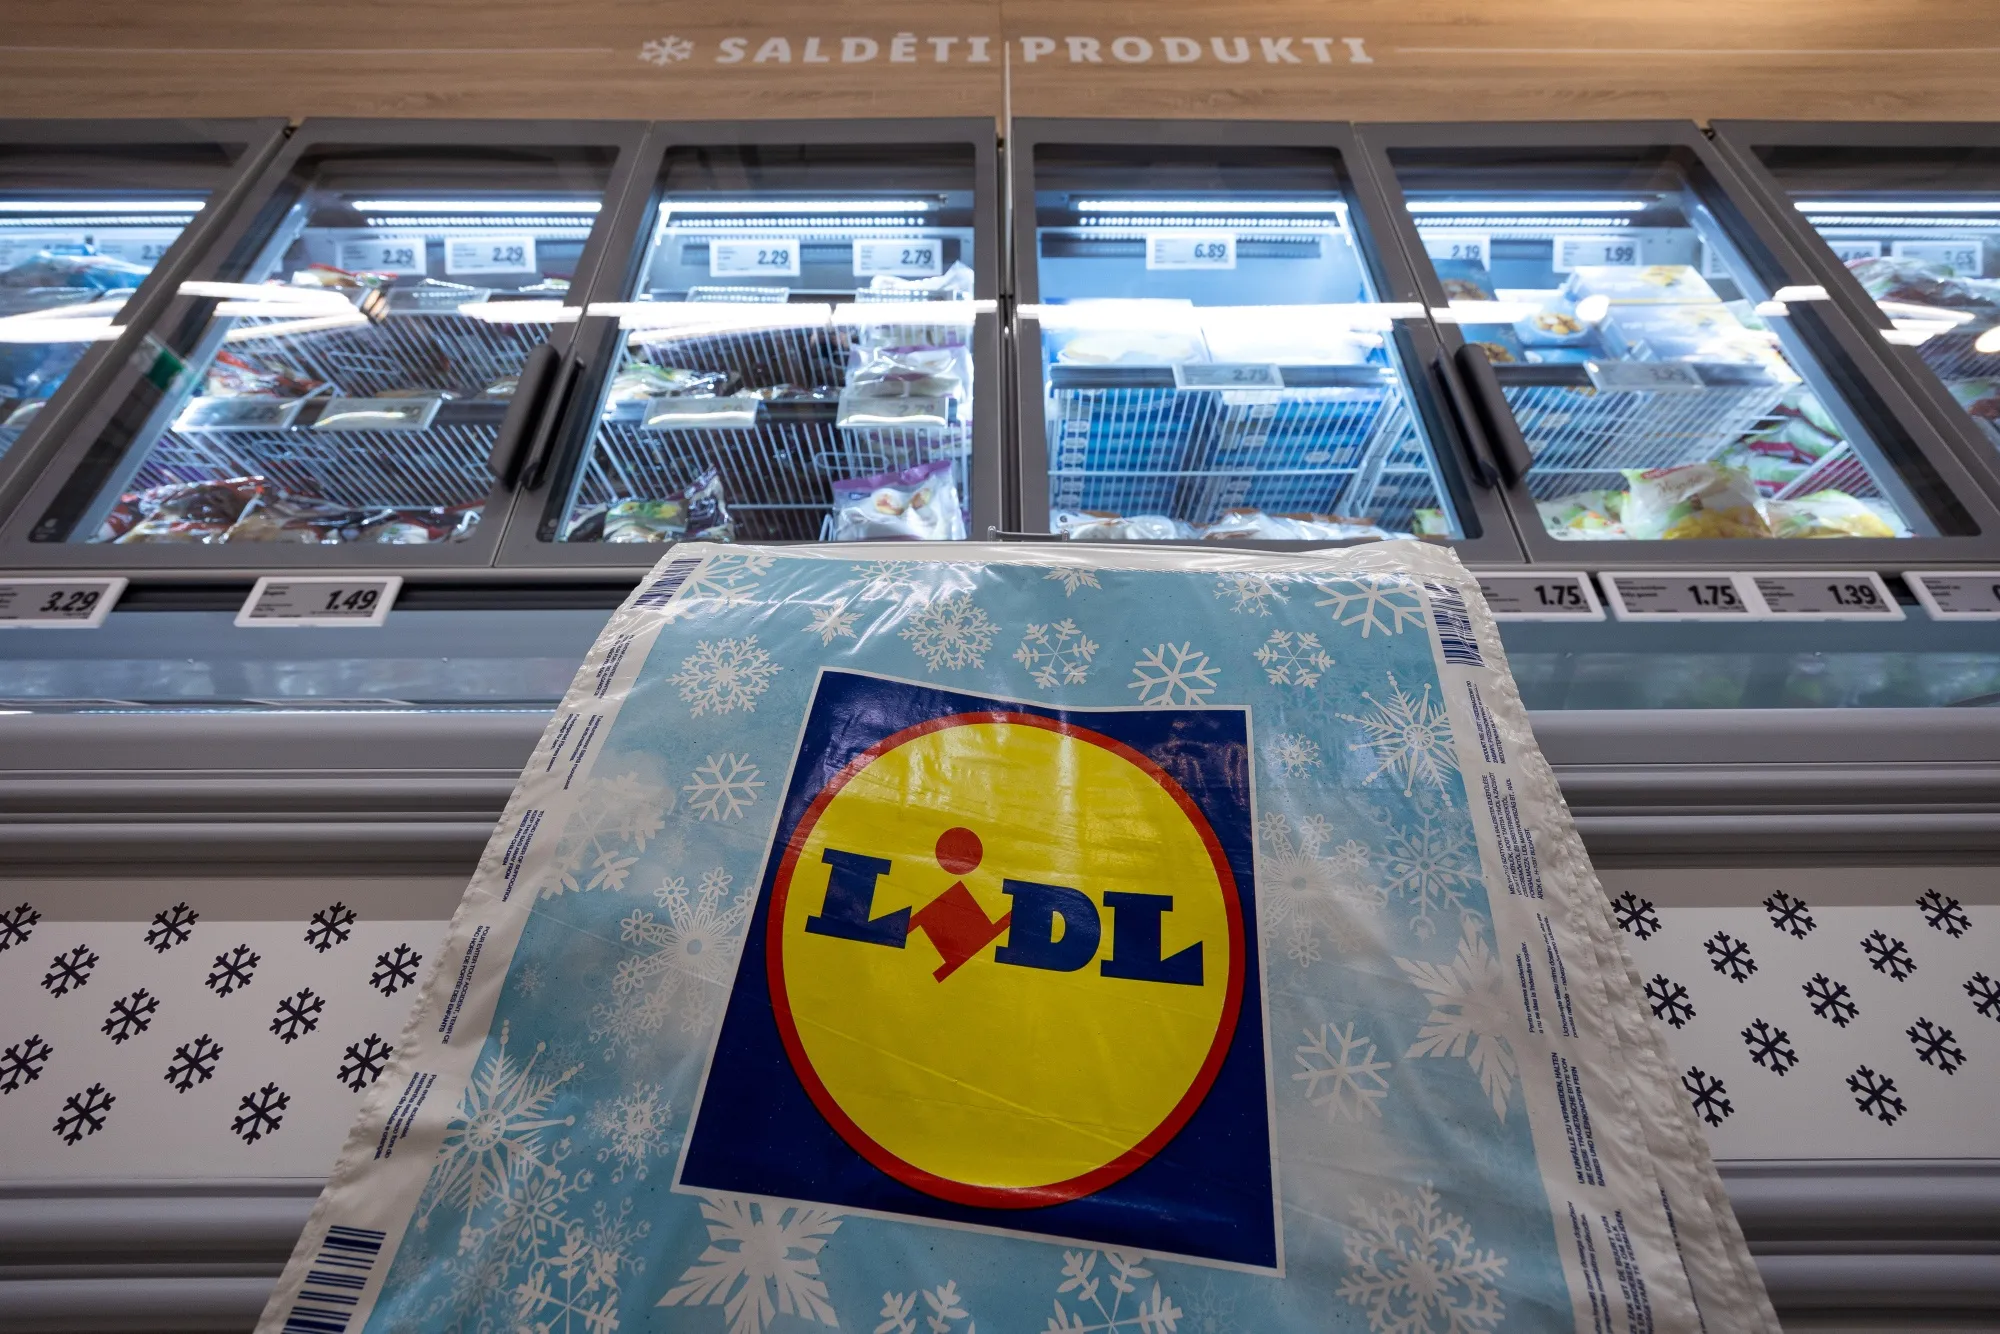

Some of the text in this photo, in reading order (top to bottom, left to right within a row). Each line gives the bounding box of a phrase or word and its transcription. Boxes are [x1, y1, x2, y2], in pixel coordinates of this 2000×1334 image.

[716, 32, 1375, 65] SALDĒTI PRODUKTI
[383, 249, 414, 265] 2.29
[492, 246, 524, 262] 2.29
[757, 250, 789, 265] 2.29
[900, 249, 933, 264] 2.79
[1193, 243, 1226, 259] 6.89
[1604, 247, 1634, 262] 1.99
[40, 591, 100, 612] 3.29
[325, 589, 378, 610] 1.49
[1534, 585, 1580, 605] 1.75
[1687, 585, 1736, 605] 1.75
[1827, 585, 1877, 605] 1.39
[1481, 741, 1491, 762] PRODUKT
[530, 818, 540, 832] AVOID
[1489, 806, 1500, 833] BALESETEK
[1499, 817, 1507, 835] TARTSA
[502, 810, 532, 865] BABIES AND CHILDREN
[504, 810, 538, 879] KEEP THIS BAG AWAY FROM
[520, 834, 533, 855] DANGER
[1503, 836, 1512, 851] HOGY
[518, 856, 523, 864] OF
[502, 864, 520, 902] SUFFOCATION
[1536, 883, 1544, 900] ÁROK
[1547, 945, 1555, 966] dosahu
[439, 926, 483, 1032] SAC HORS DE PORTÉE DES ENFANTS
[442, 926, 490, 1044] POUR EVITER TOUT ACCIDENT, TENIR CE
[1523, 989, 1531, 1012] evitarea
[1564, 993, 1572, 1015] nehode
[1527, 1013, 1535, 1033] Pentru
[404, 1072, 419, 1096] alcance
[1564, 1074, 1574, 1094] BITTE
[398, 1096, 406, 1105] de
[400, 1075, 437, 1139] Para evitar acidentes,
[385, 1073, 428, 1158] mantenha este saco fora do
[1552, 1052, 1585, 1184] UM UNFÄLLE ZU VERMEIDEN, HALTEN
[1568, 1095, 1585, 1147] TRAGETASCHE
[1571, 1066, 1605, 1187] BABIES UND KLEINKINDERN FERN
[1580, 1149, 1592, 1171] DIESE
[1586, 1172, 1595, 1186] SIE
[1601, 1216, 1612, 1233] VAN
[1612, 1225, 1622, 1242] ELK
[1608, 1236, 1622, 1266] BUURT
[1618, 1245, 1627, 1260] OM
[1617, 1269, 1626, 1282] DE
[1632, 1265, 1640, 1275] TE
[1621, 1285, 1630, 1300] UIT
[1636, 1313, 1644, 1326] EN
